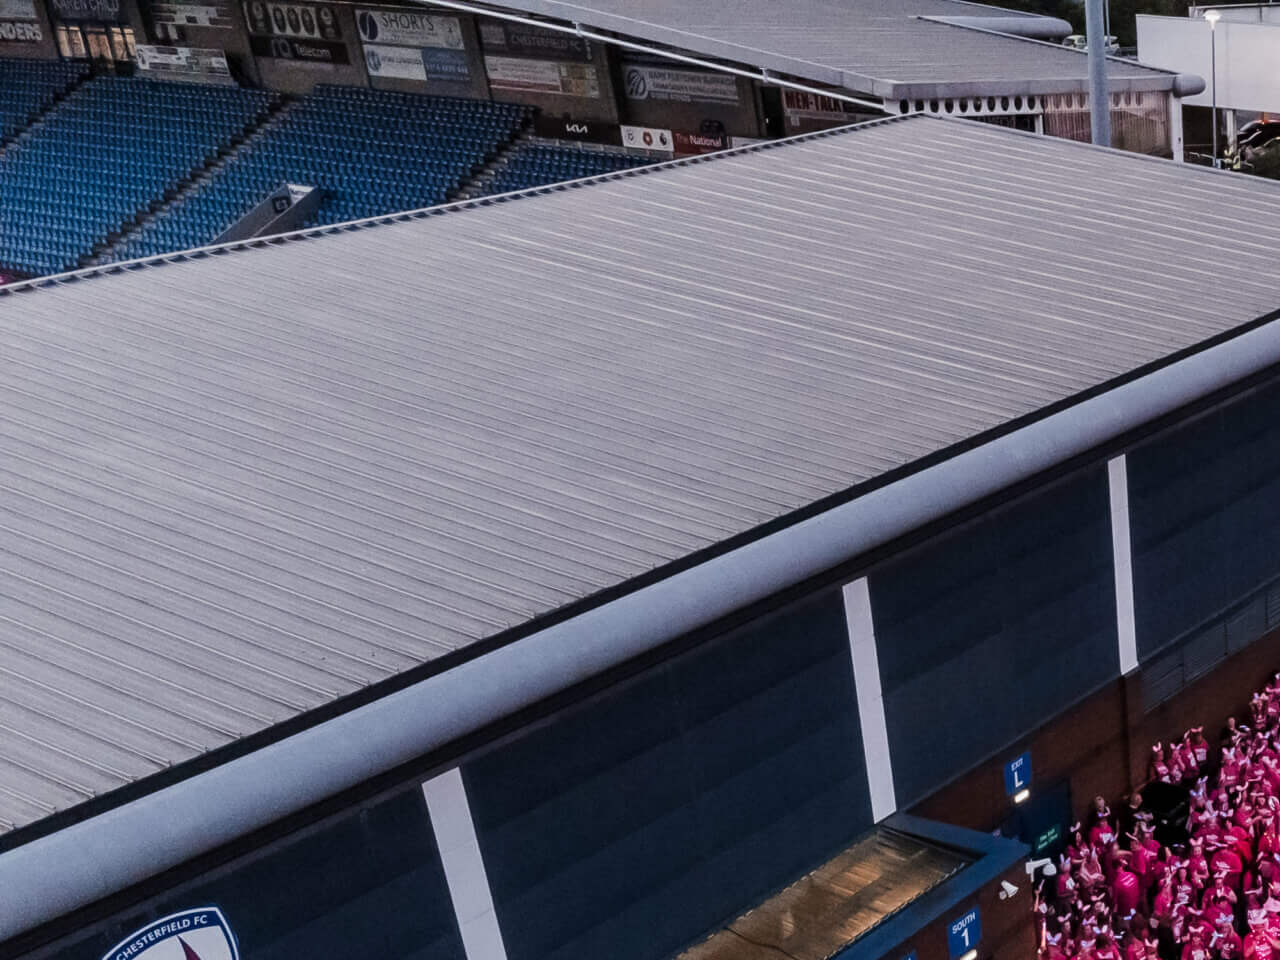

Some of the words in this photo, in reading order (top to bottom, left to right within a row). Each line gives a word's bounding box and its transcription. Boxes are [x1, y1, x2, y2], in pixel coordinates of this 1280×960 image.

[1014, 771, 1024, 787] L
[194, 915, 208, 926] FC
[952, 911, 976, 934] SOUTH
[961, 928, 970, 947] 1
